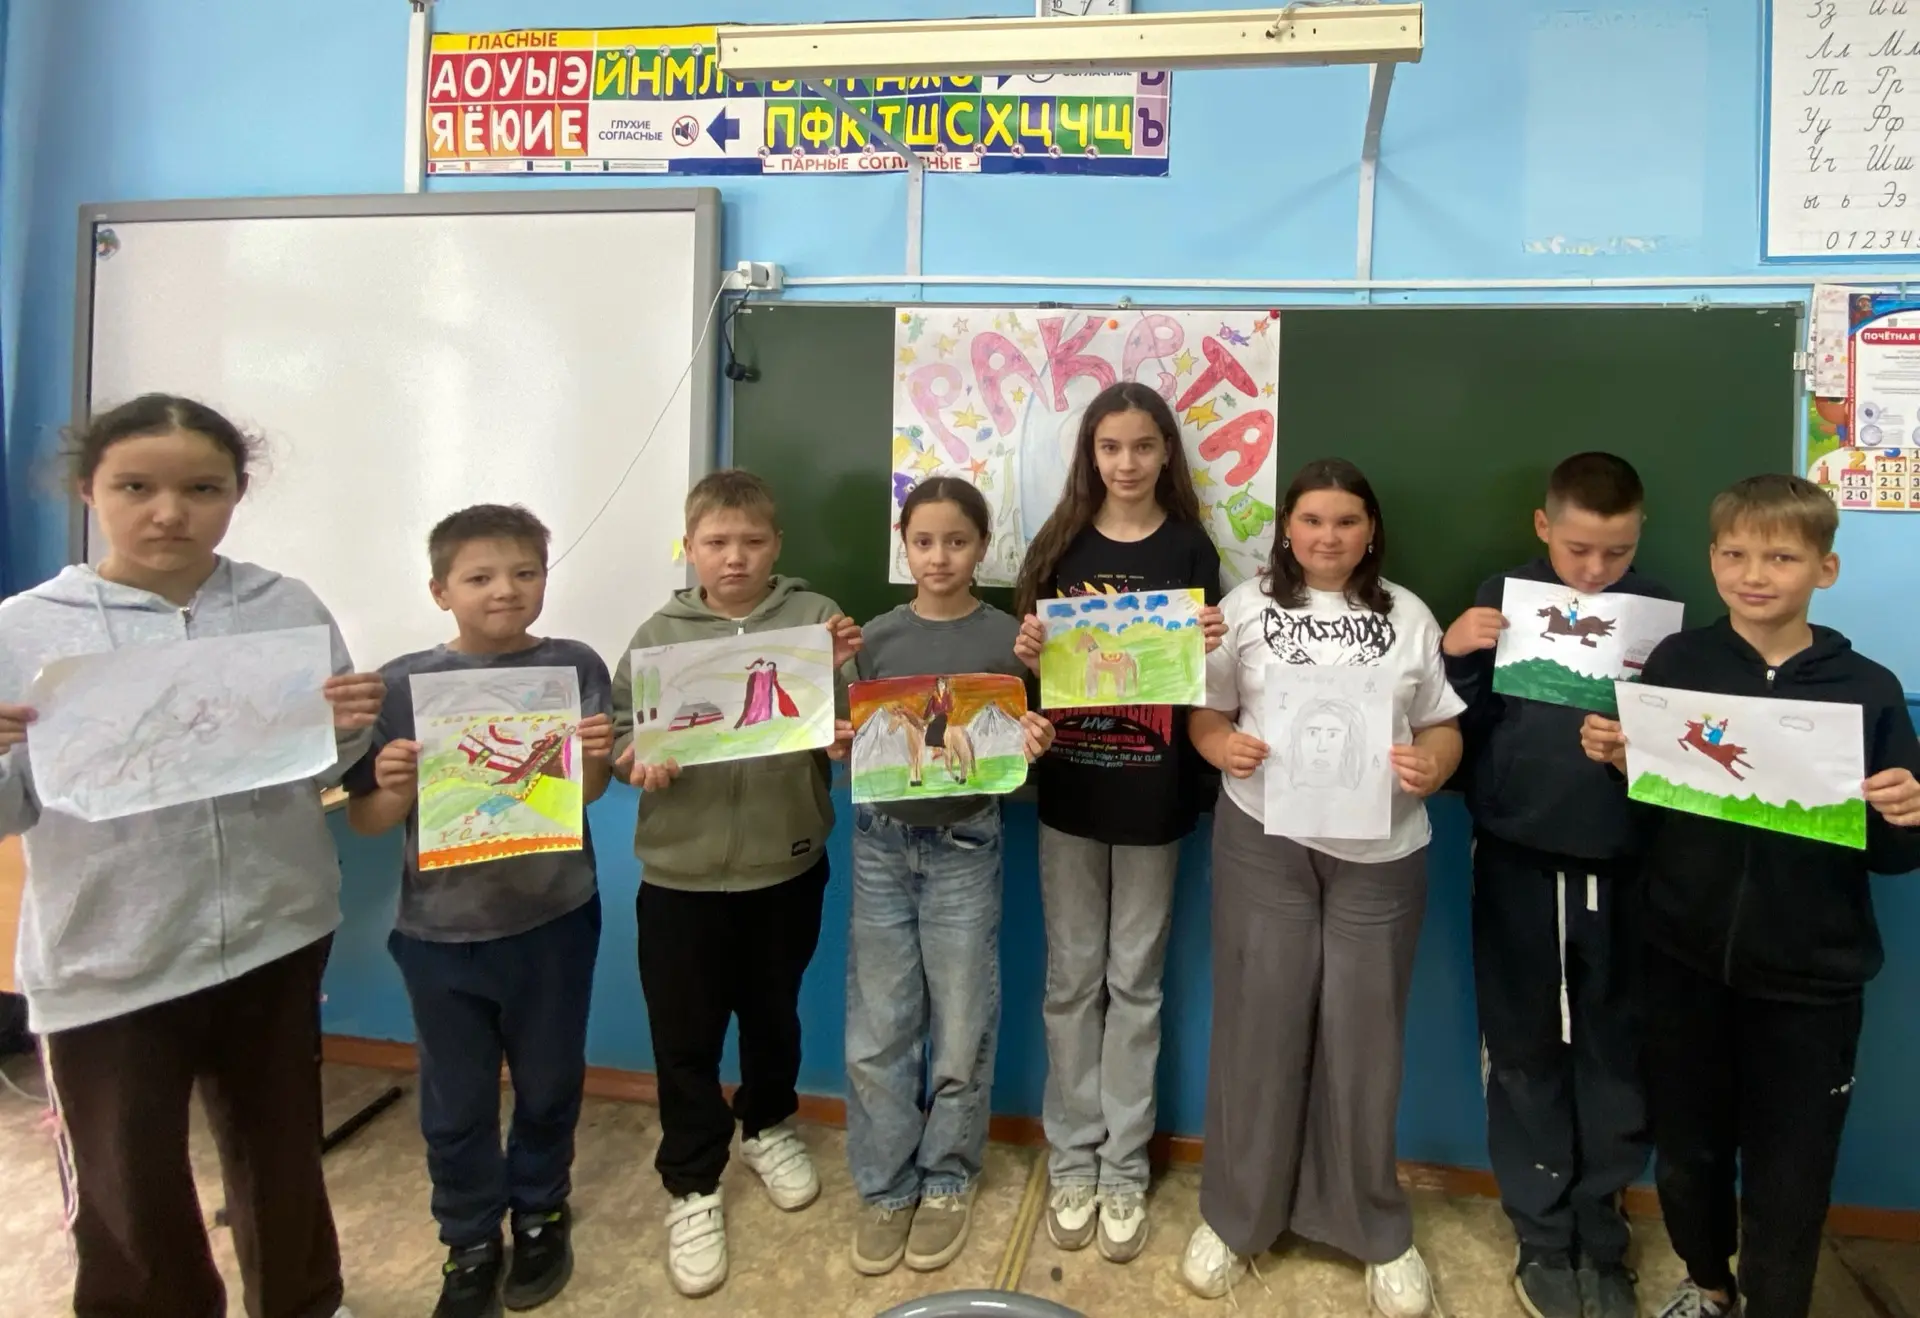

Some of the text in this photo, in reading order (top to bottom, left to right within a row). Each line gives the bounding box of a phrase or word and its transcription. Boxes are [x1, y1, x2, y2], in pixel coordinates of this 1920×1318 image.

[468, 32, 559, 50] ГЛАСНЫЕ
[611, 120, 651, 129] ГЛУХИЕ
[598, 131, 663, 141] СОГЛАСНЫЕ
[781, 156, 962, 171] ПАРНЫЕ СОГЛНЫЕ
[1864, 331, 1916, 341] ПОЧЁТНАЯ
[1080, 716, 1117, 730] LIVE
